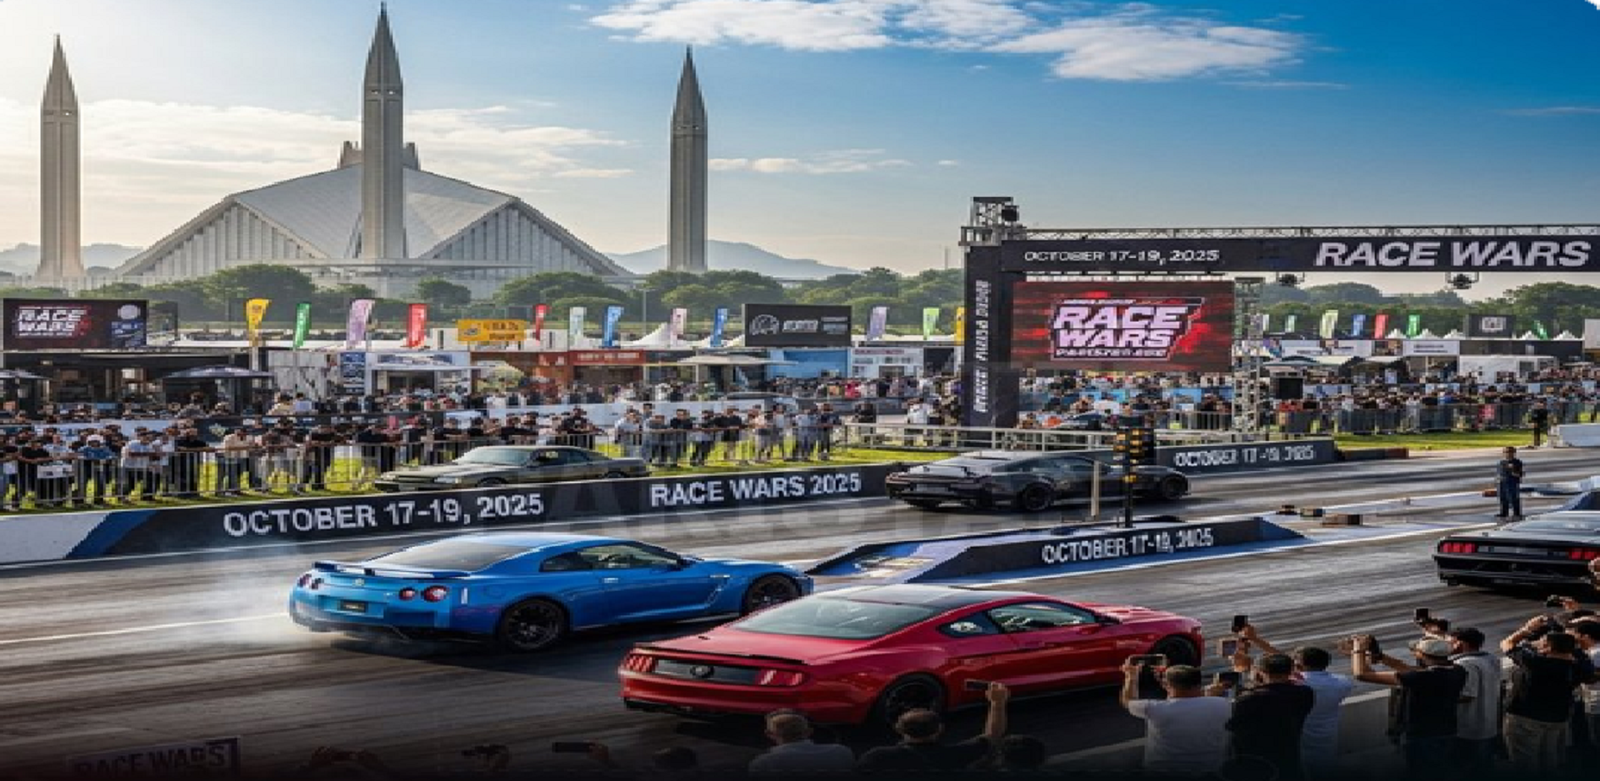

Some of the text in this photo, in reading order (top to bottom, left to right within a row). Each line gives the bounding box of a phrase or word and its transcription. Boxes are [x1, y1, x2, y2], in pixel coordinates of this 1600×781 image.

[1024, 250, 1104, 262] OCTOBER
[1169, 250, 1220, 262] 2025
[1315, 241, 1591, 267] RACE WARS
[1054, 306, 1188, 329] RACE
[1059, 329, 1174, 347] WARS
[651, 472, 862, 507] RACE WARS 2025
[224, 493, 544, 537] OCTOBER 17-19, 2025
[1042, 537, 1128, 564] OCTOBER
